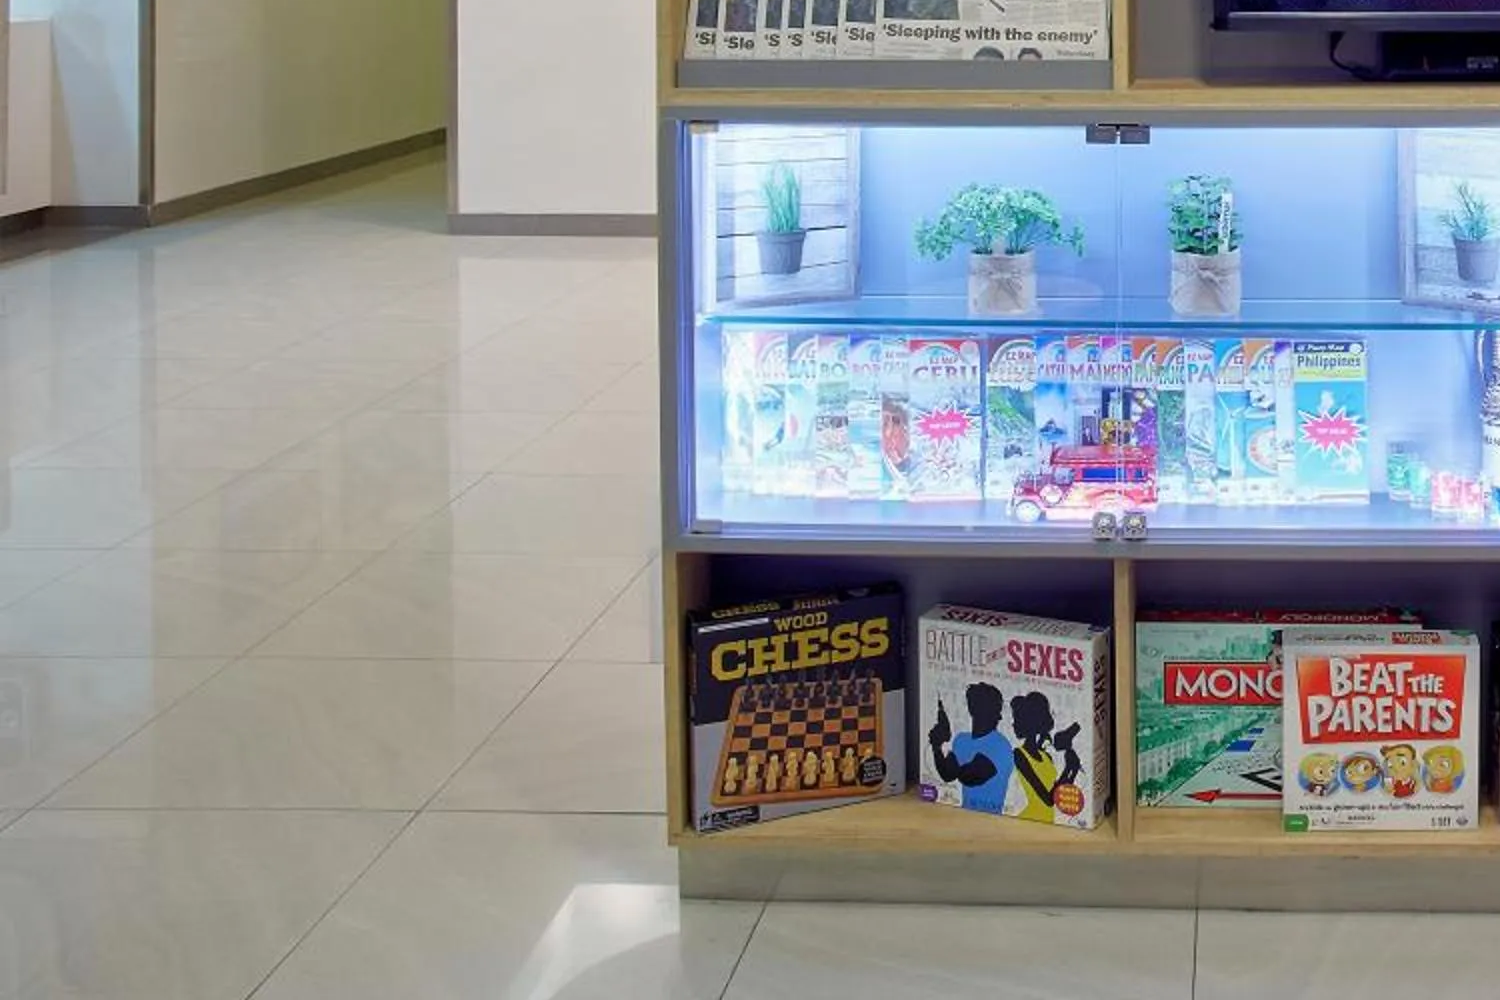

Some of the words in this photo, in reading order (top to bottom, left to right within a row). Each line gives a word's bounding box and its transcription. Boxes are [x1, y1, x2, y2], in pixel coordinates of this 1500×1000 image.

[965, 26, 1001, 41] with
[1004, 28, 1033, 41] the
[1297, 353, 1361, 369] Philippines
[773, 611, 829, 632] WOOD
[711, 617, 891, 682] CHESS
[926, 629, 989, 667] BATTLE
[1007, 639, 1084, 683] SEXES
[1330, 654, 1413, 698] BEAT
[1407, 673, 1444, 695] THE
[1308, 696, 1456, 739] PARENTS
